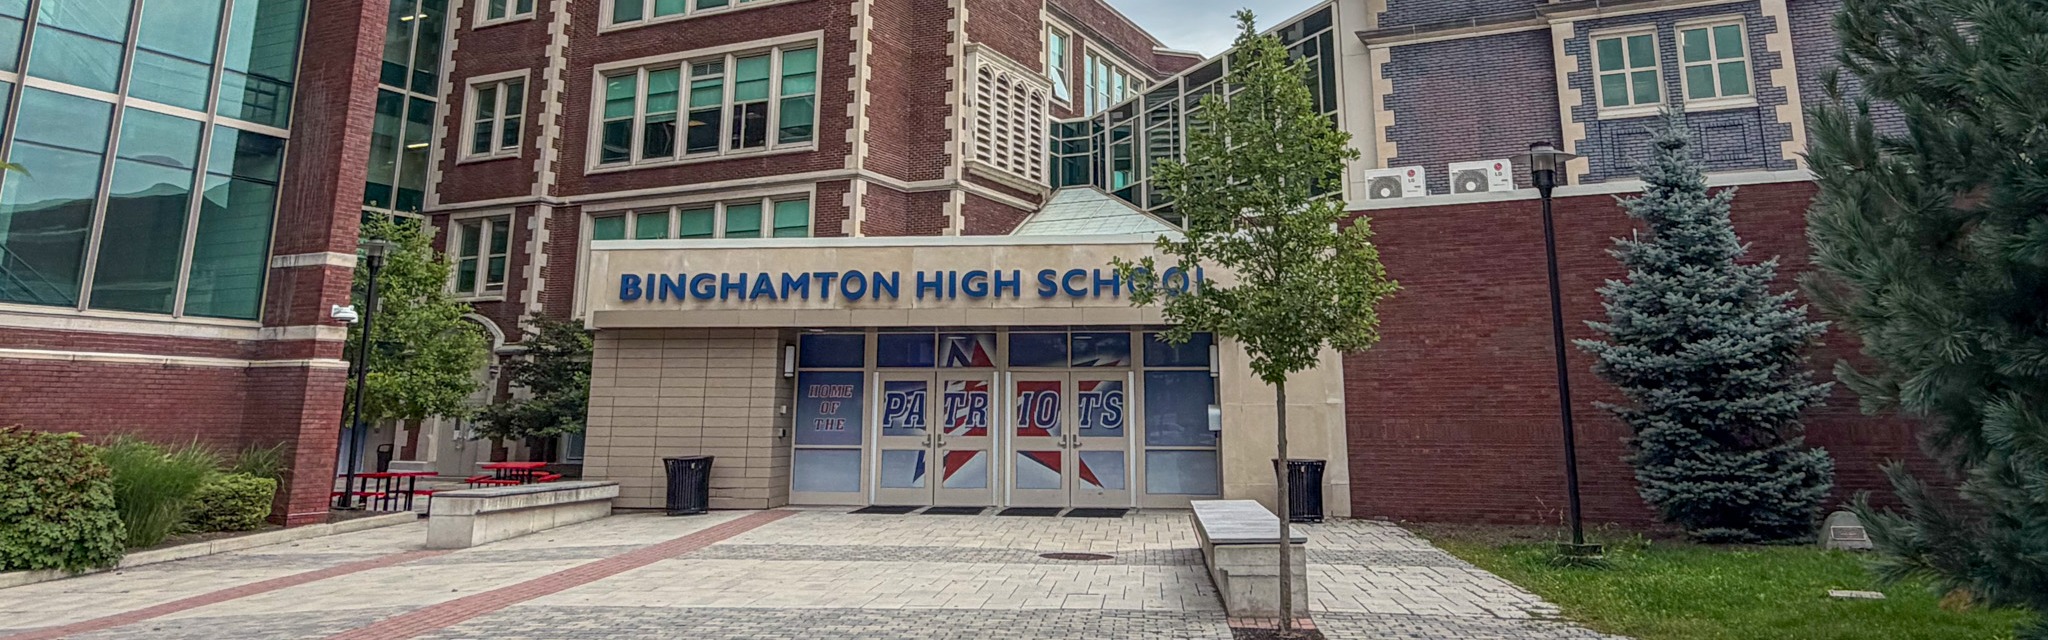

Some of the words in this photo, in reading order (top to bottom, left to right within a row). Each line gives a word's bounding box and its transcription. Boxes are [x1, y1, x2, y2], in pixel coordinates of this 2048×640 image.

[619, 270, 900, 301] BINGHAMTON
[916, 269, 1021, 300] HIGH
[808, 384, 854, 398] HOME
[819, 400, 841, 415] OF
[883, 390, 1124, 429] PATRIOTS
[813, 417, 846, 431] THE
